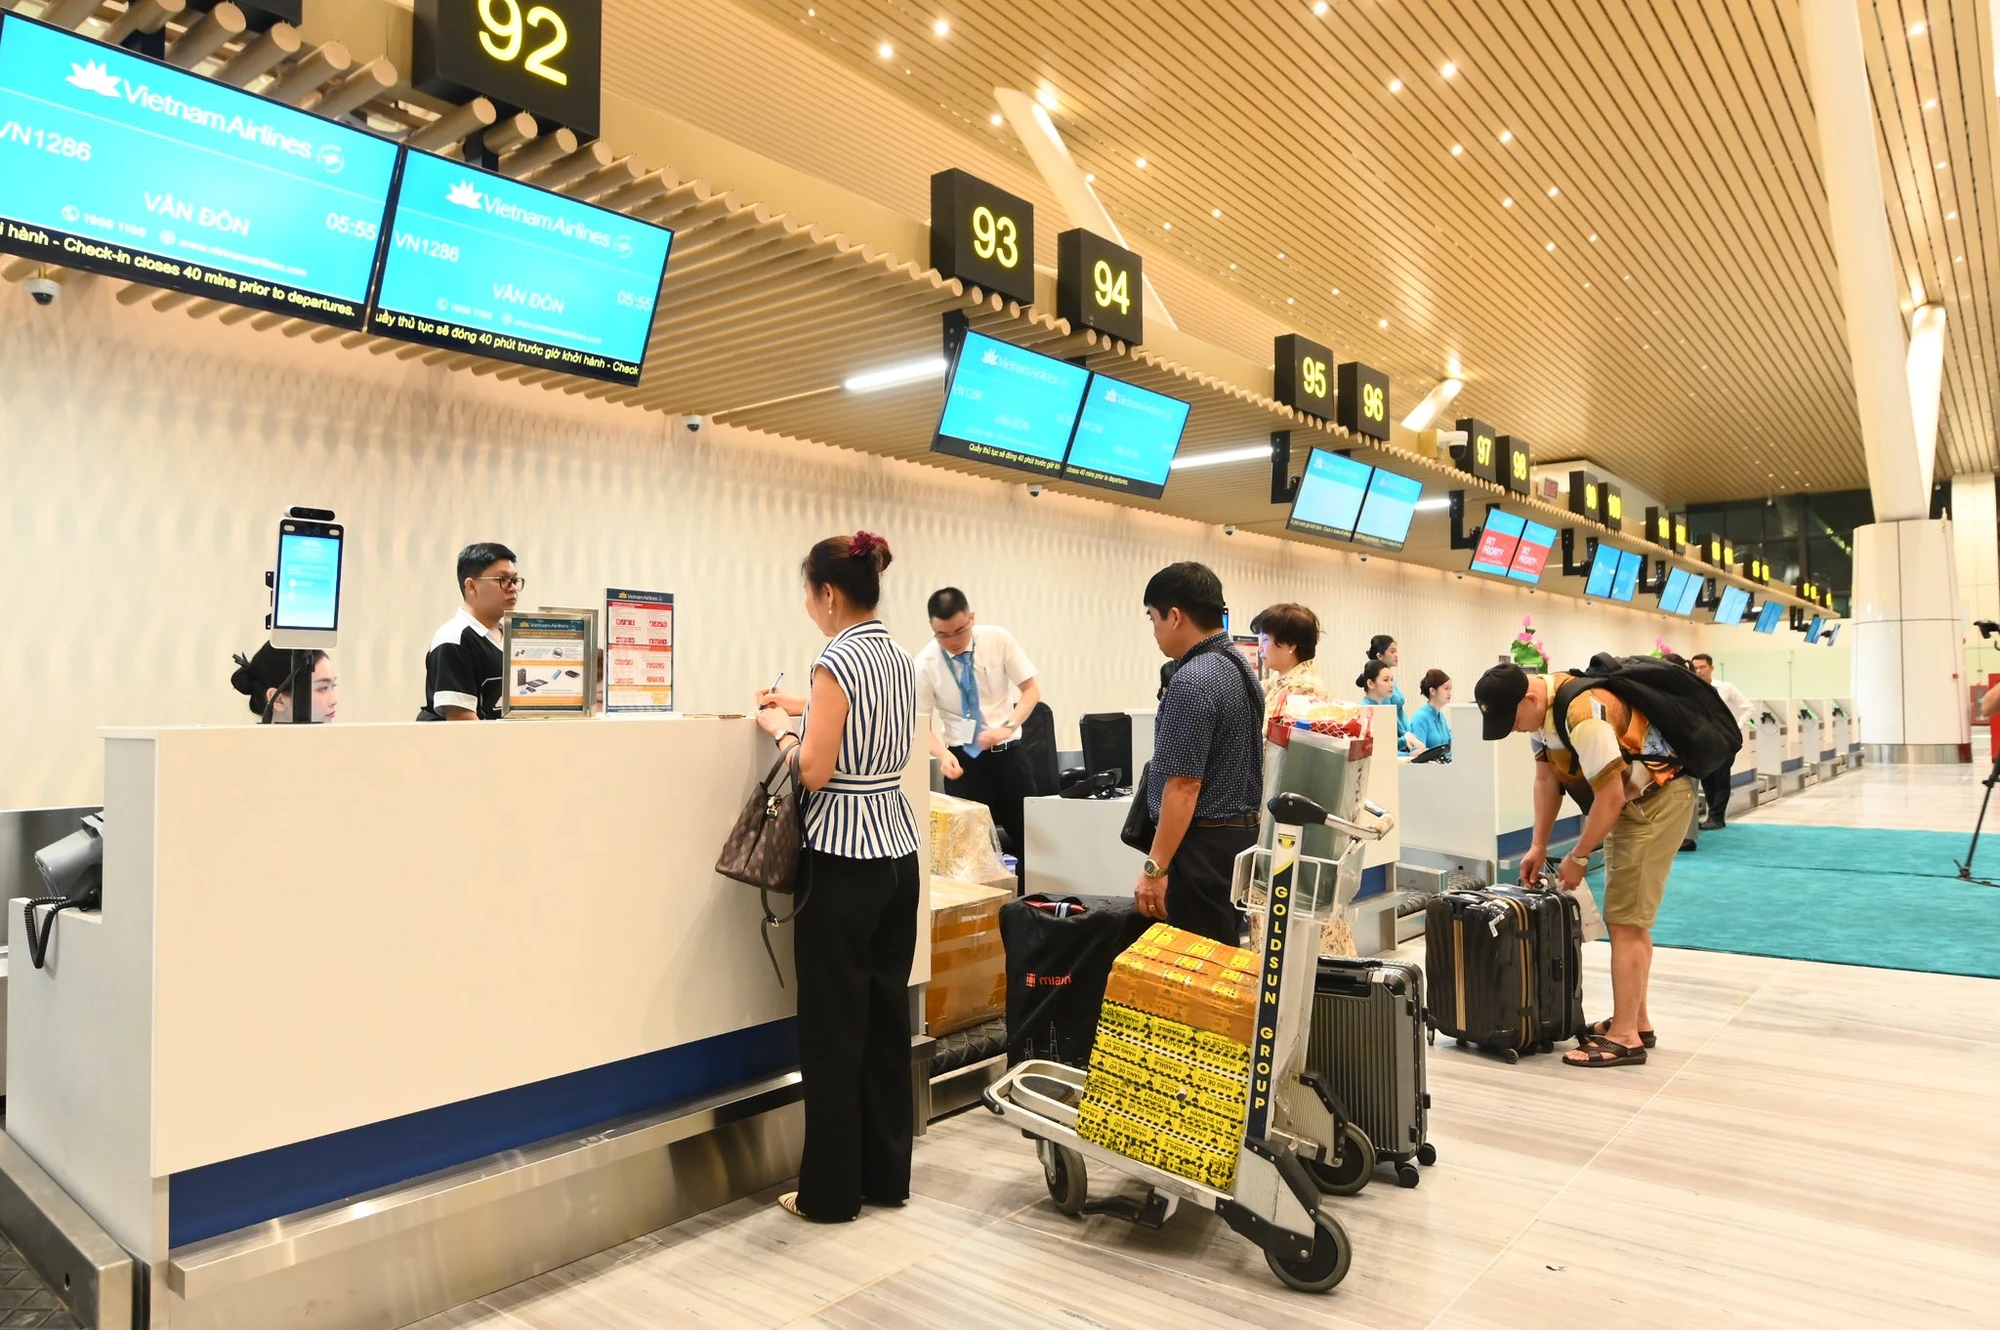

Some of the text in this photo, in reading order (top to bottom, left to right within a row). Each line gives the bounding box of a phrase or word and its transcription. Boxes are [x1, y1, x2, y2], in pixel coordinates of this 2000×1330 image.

[478, 0, 568, 86] 92
[123, 79, 312, 158] Vietnam Airlines
[326, 212, 377, 241] 05:55
[482, 194, 611, 248] Vietnam Airlines
[972, 206, 1018, 268] 93
[8, 223, 49, 246] hành
[64, 237, 131, 265] Check-in
[134, 255, 180, 279] closes
[183, 264, 202, 281] 40
[205, 270, 237, 289] mins
[239, 277, 270, 298] prior
[273, 286, 285, 300] to
[287, 289, 356, 317] departures.
[393, 231, 460, 263] VN1286
[1094, 260, 1130, 315] 94
[479, 332, 492, 345] 40
[613, 361, 639, 375] Check
[1303, 356, 1327, 398] 95
[1363, 383, 1384, 421] 96
[1477, 434, 1492, 466] 97
[1513, 450, 1527, 481] 98
[1254, 885, 1289, 1110] GOLDSUN GROUP
